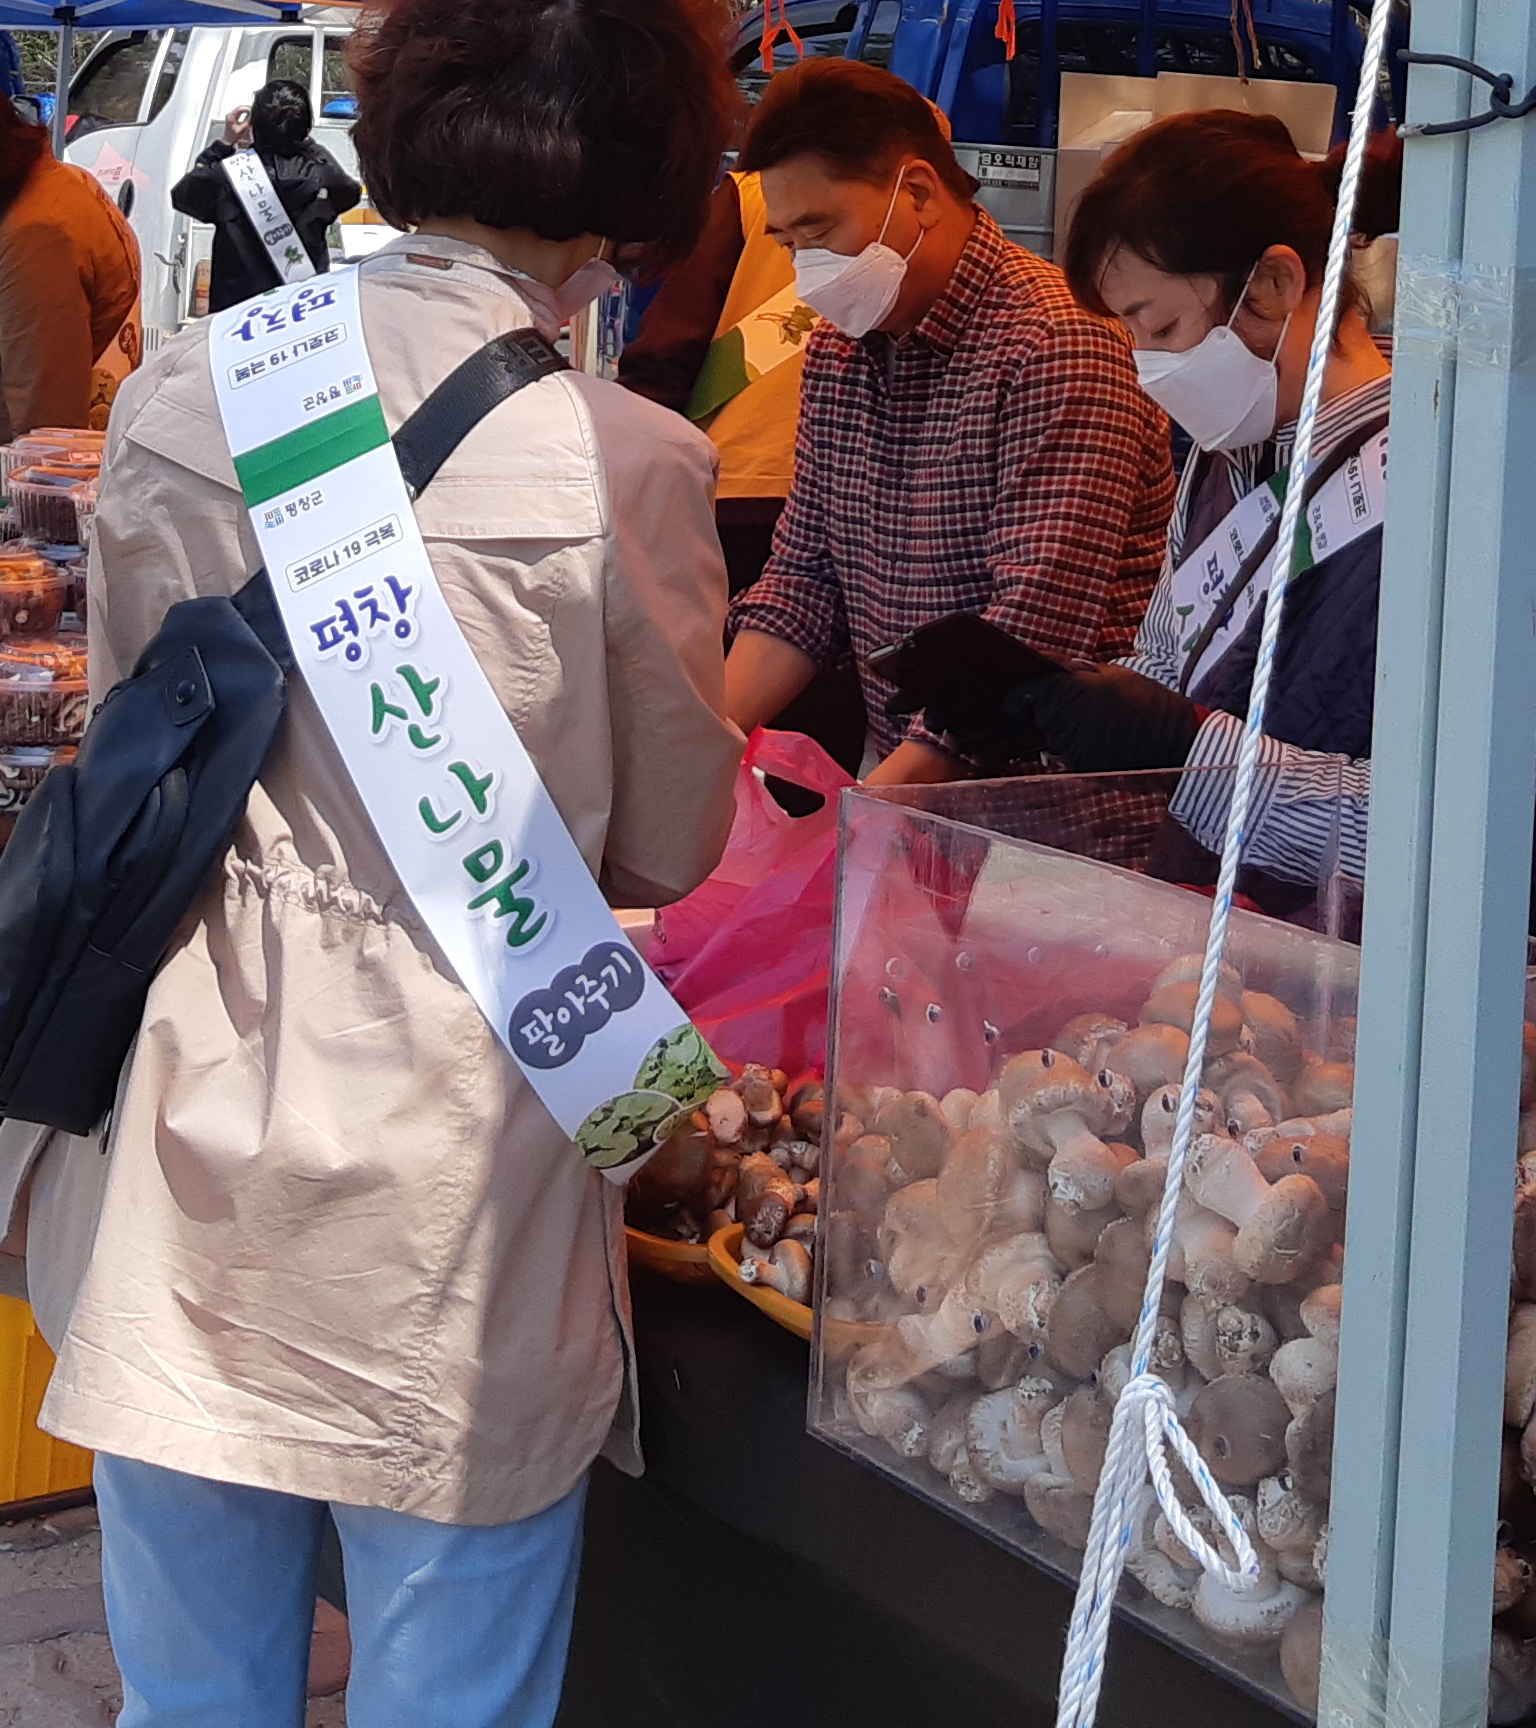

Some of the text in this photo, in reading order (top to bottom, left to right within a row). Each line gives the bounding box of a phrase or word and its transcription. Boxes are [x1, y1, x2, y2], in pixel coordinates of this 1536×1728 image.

[240, 164, 276, 223] 산나물
[231, 287, 337, 342] 평창
[293, 327, 340, 357] 코로나
[269, 347, 289, 366] 19
[302, 385, 342, 411] 평창군
[284, 489, 324, 518] 평창군
[294, 521, 396, 586] 코로나 19 극복
[309, 574, 413, 663] 평창
[370, 663, 549, 948] 산나물
[519, 950, 632, 1057] 팔아주기
